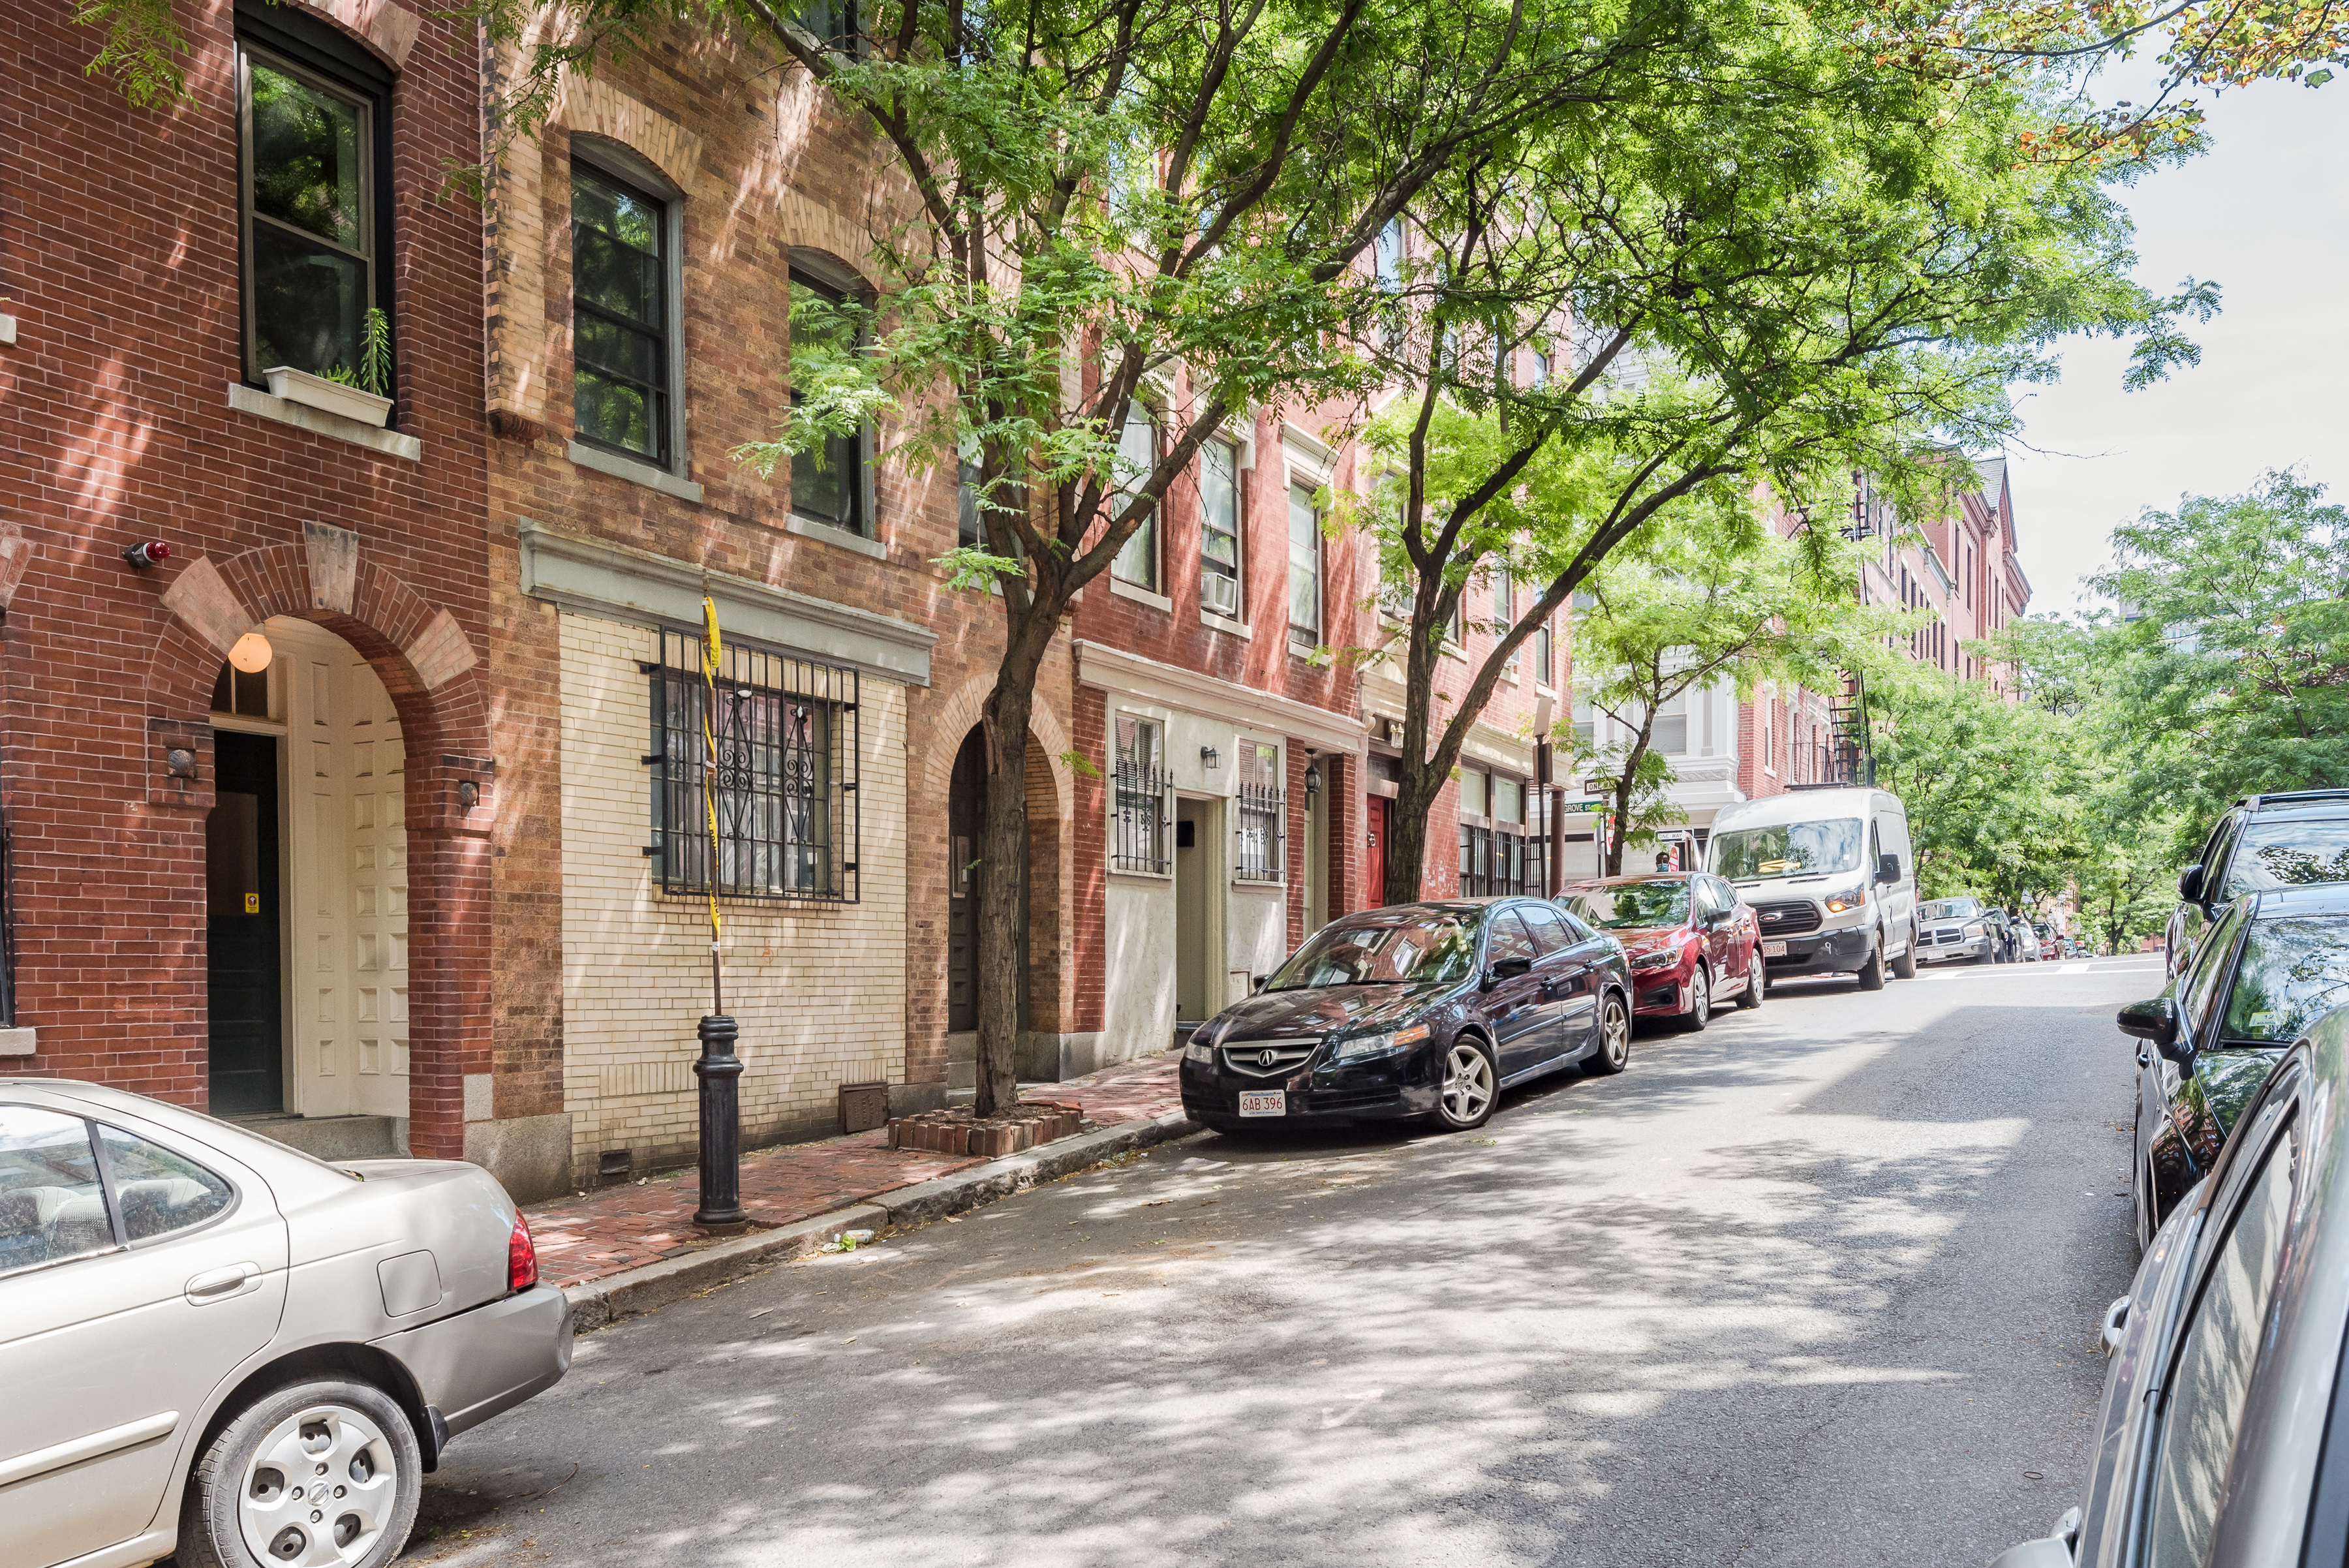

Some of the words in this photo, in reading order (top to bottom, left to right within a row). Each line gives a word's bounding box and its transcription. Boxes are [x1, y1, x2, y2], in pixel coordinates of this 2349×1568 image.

[1565, 803, 1583, 812] GROVE
[1242, 1098, 1261, 1111] 6AB
[1263, 1097, 1283, 1110] 396
